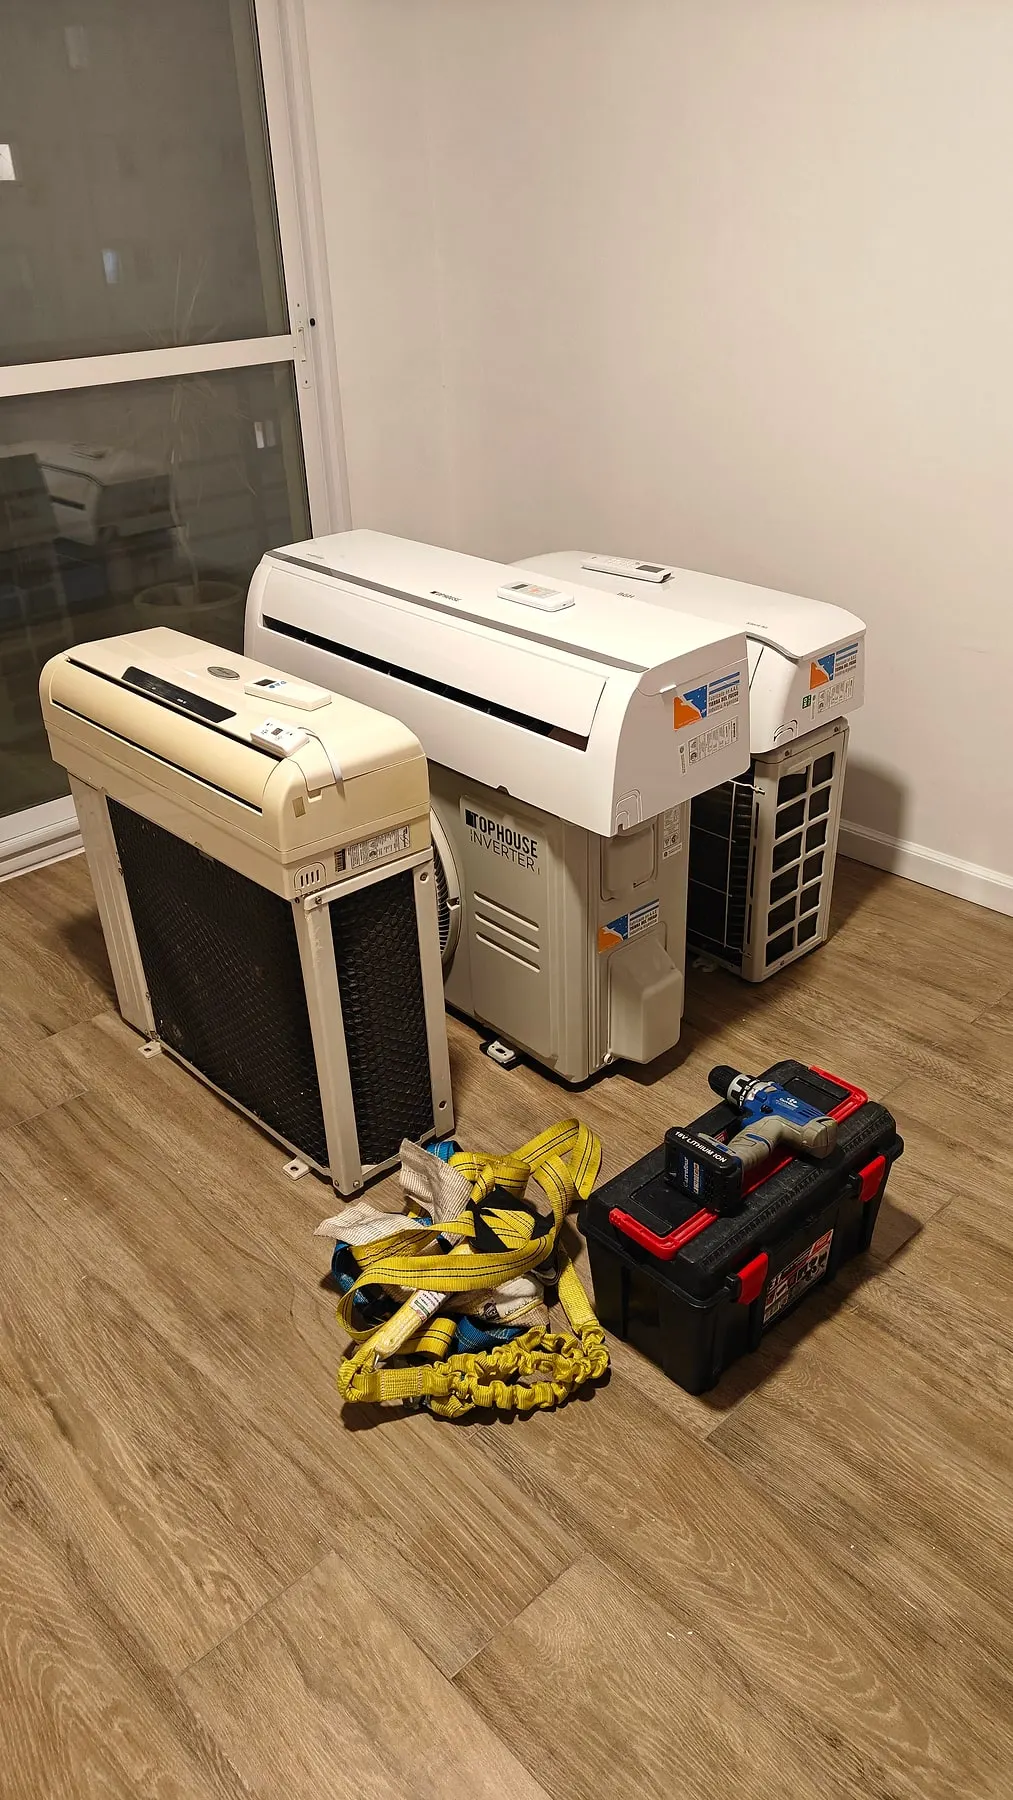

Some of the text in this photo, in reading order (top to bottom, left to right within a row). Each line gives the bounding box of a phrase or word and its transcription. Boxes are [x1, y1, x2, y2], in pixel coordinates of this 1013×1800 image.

[468, 811, 538, 859] TOPHOUSE
[675, 1131, 727, 1163] 18V LITHIUM ION
